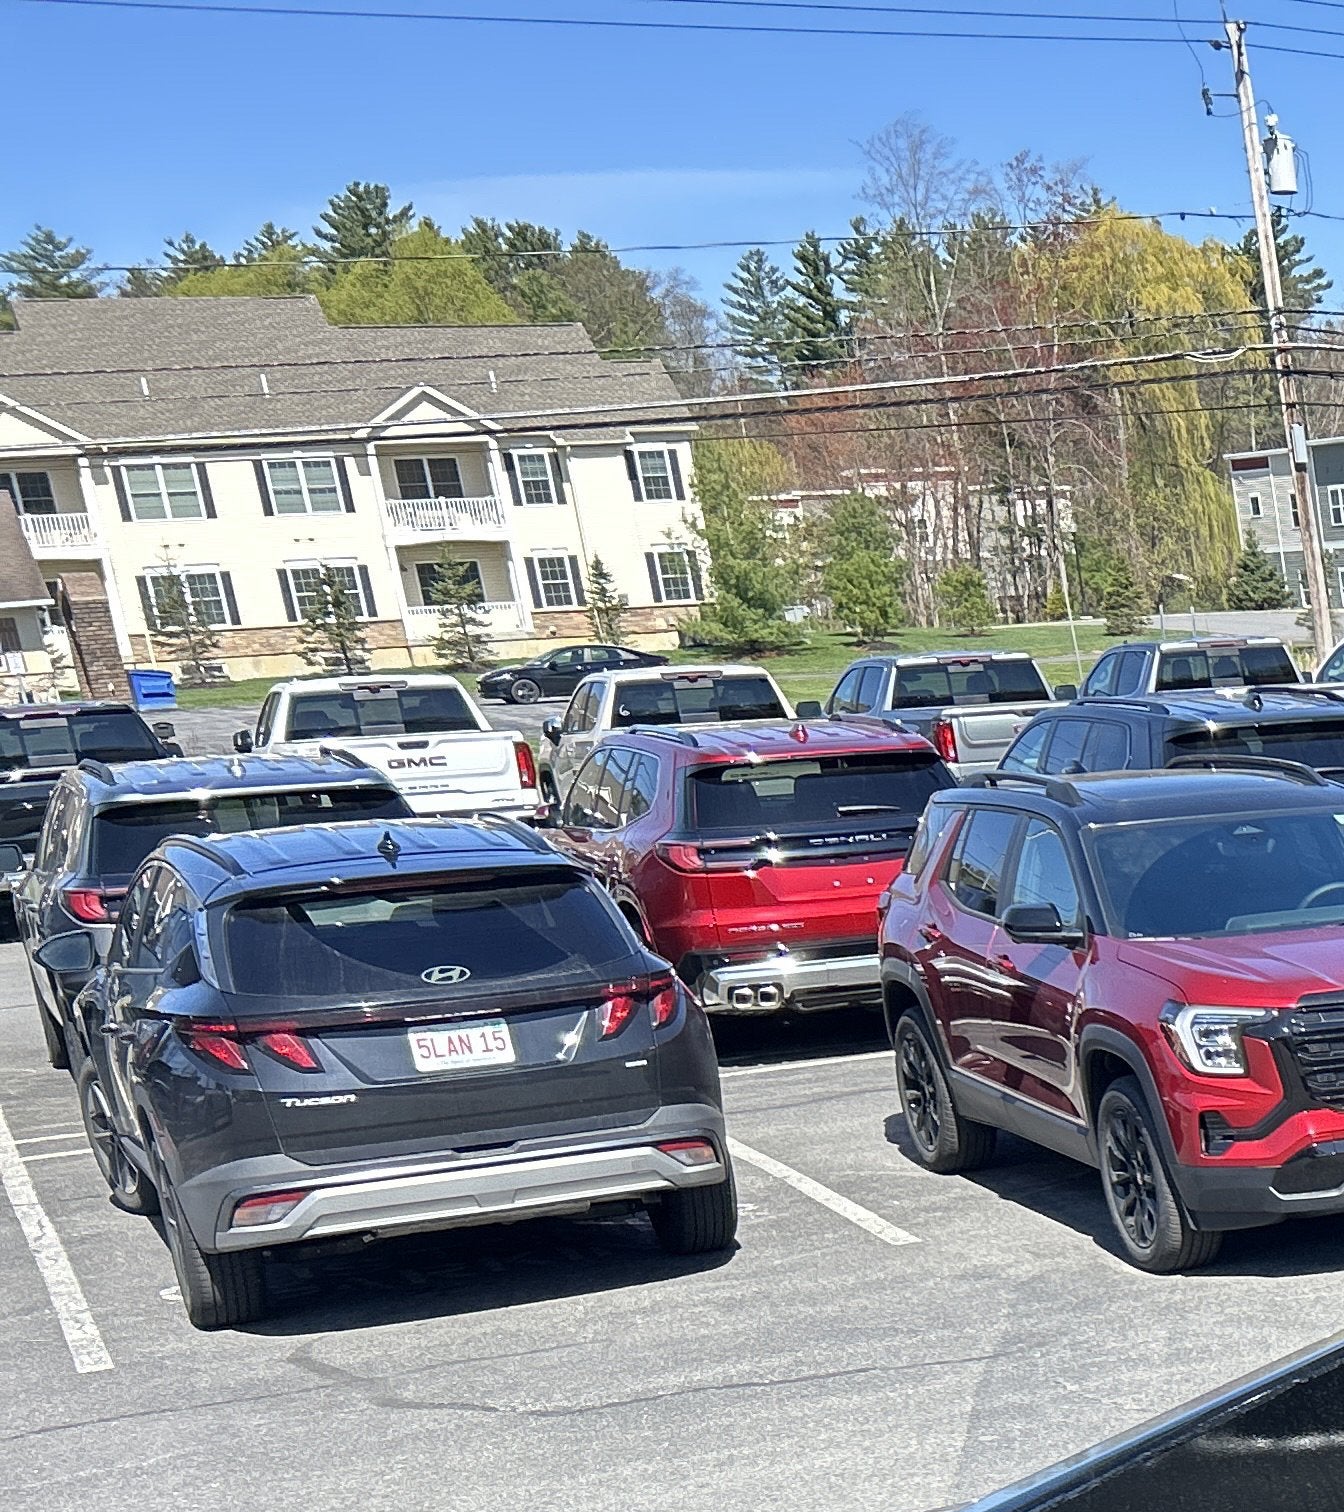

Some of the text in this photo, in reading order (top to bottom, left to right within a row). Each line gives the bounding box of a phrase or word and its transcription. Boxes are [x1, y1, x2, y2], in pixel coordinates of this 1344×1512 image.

[387, 755, 447, 769] GMC
[416, 1030, 506, 1059] 5LAN 15
